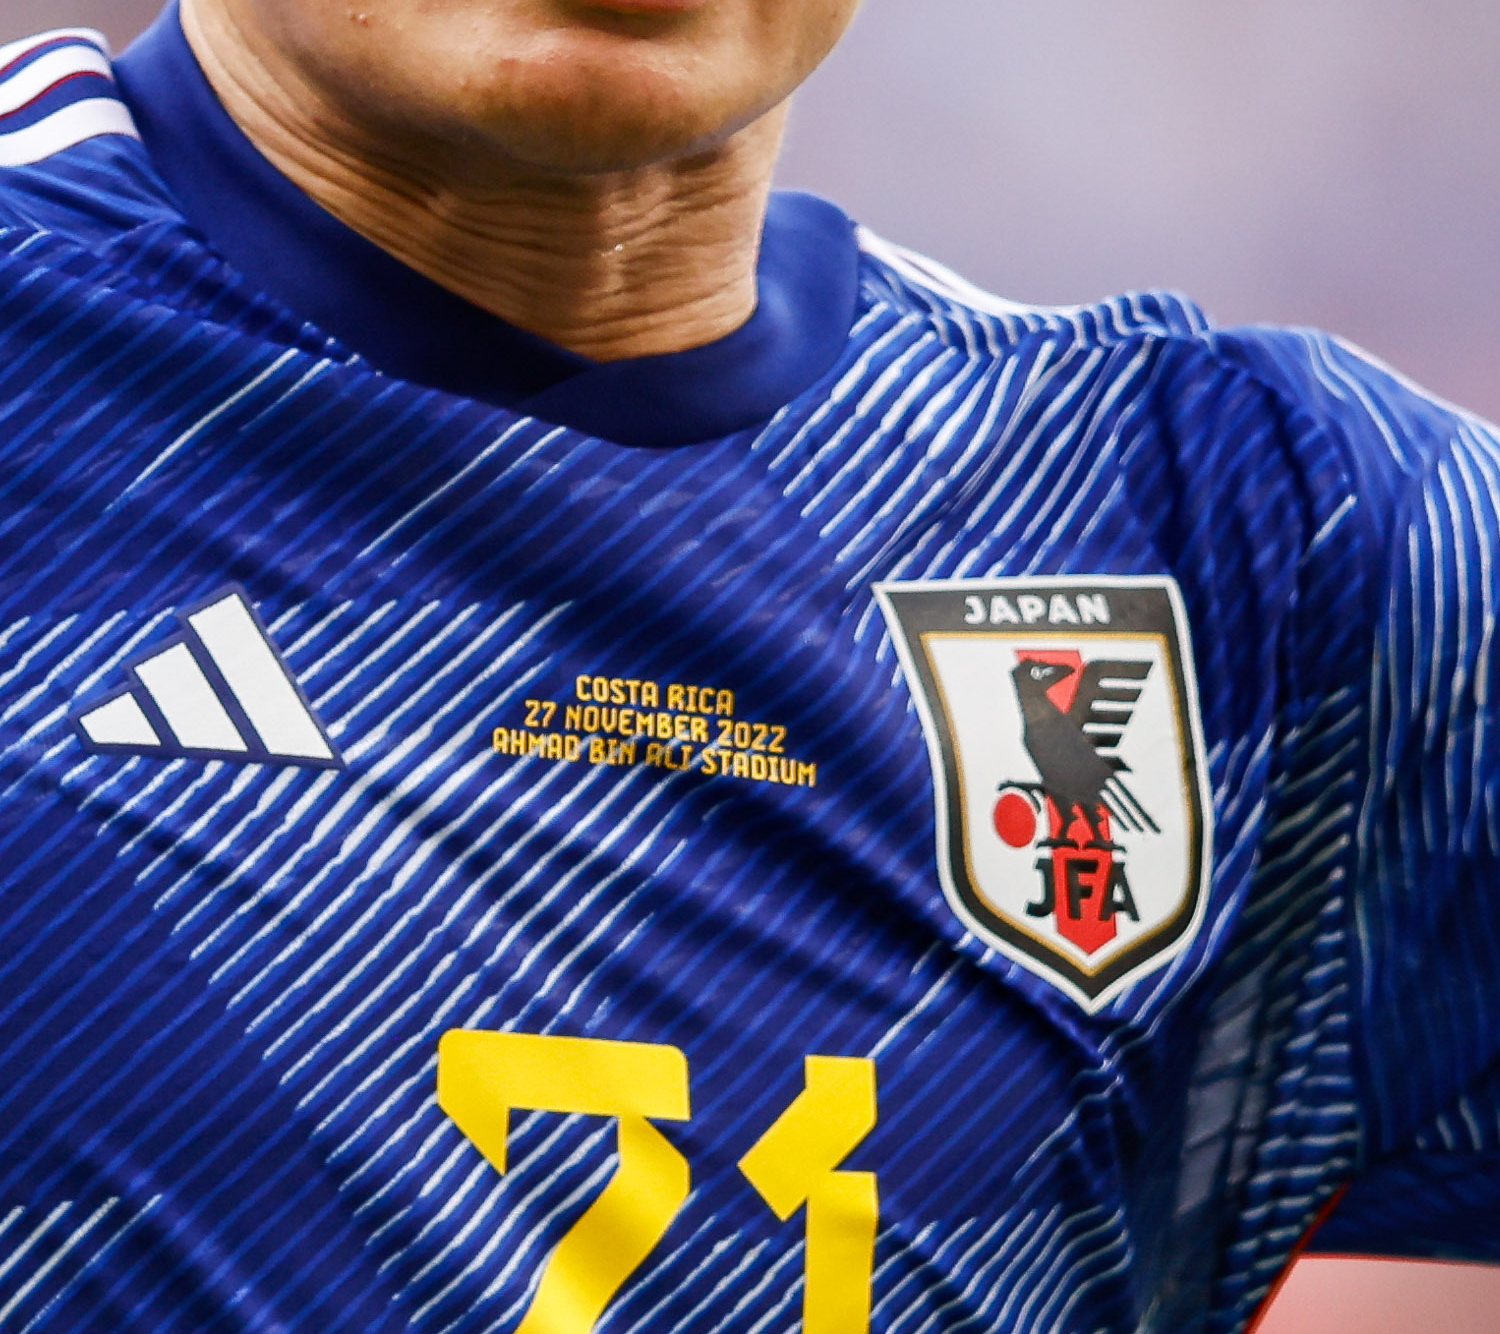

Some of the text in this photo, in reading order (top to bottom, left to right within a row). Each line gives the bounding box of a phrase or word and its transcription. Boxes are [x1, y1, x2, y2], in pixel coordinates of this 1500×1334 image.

[963, 593, 1111, 626] JAPAN
[576, 674, 735, 717] COSTA RICA
[524, 699, 788, 753] 27 NOVEMBER 2022
[492, 727, 818, 788] AHMAD BIN ALI STADIUM
[1024, 858, 1141, 923] JFA
